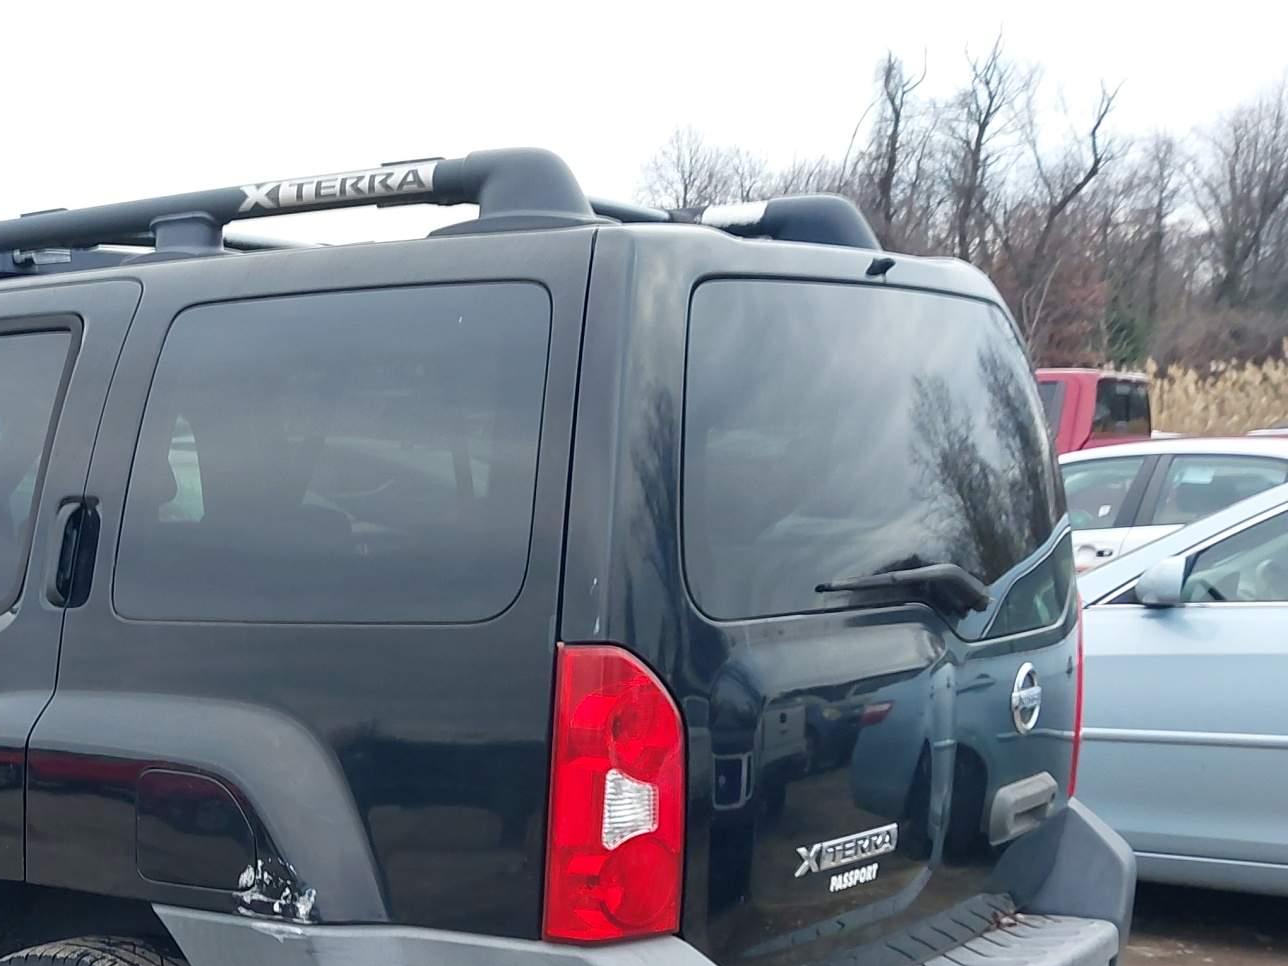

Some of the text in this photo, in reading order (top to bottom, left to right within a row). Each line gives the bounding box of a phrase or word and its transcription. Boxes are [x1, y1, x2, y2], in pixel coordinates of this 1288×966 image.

[238, 167, 428, 212] XTERRA
[794, 824, 898, 878] XTERRA
[829, 862, 880, 892] PASSPORT
